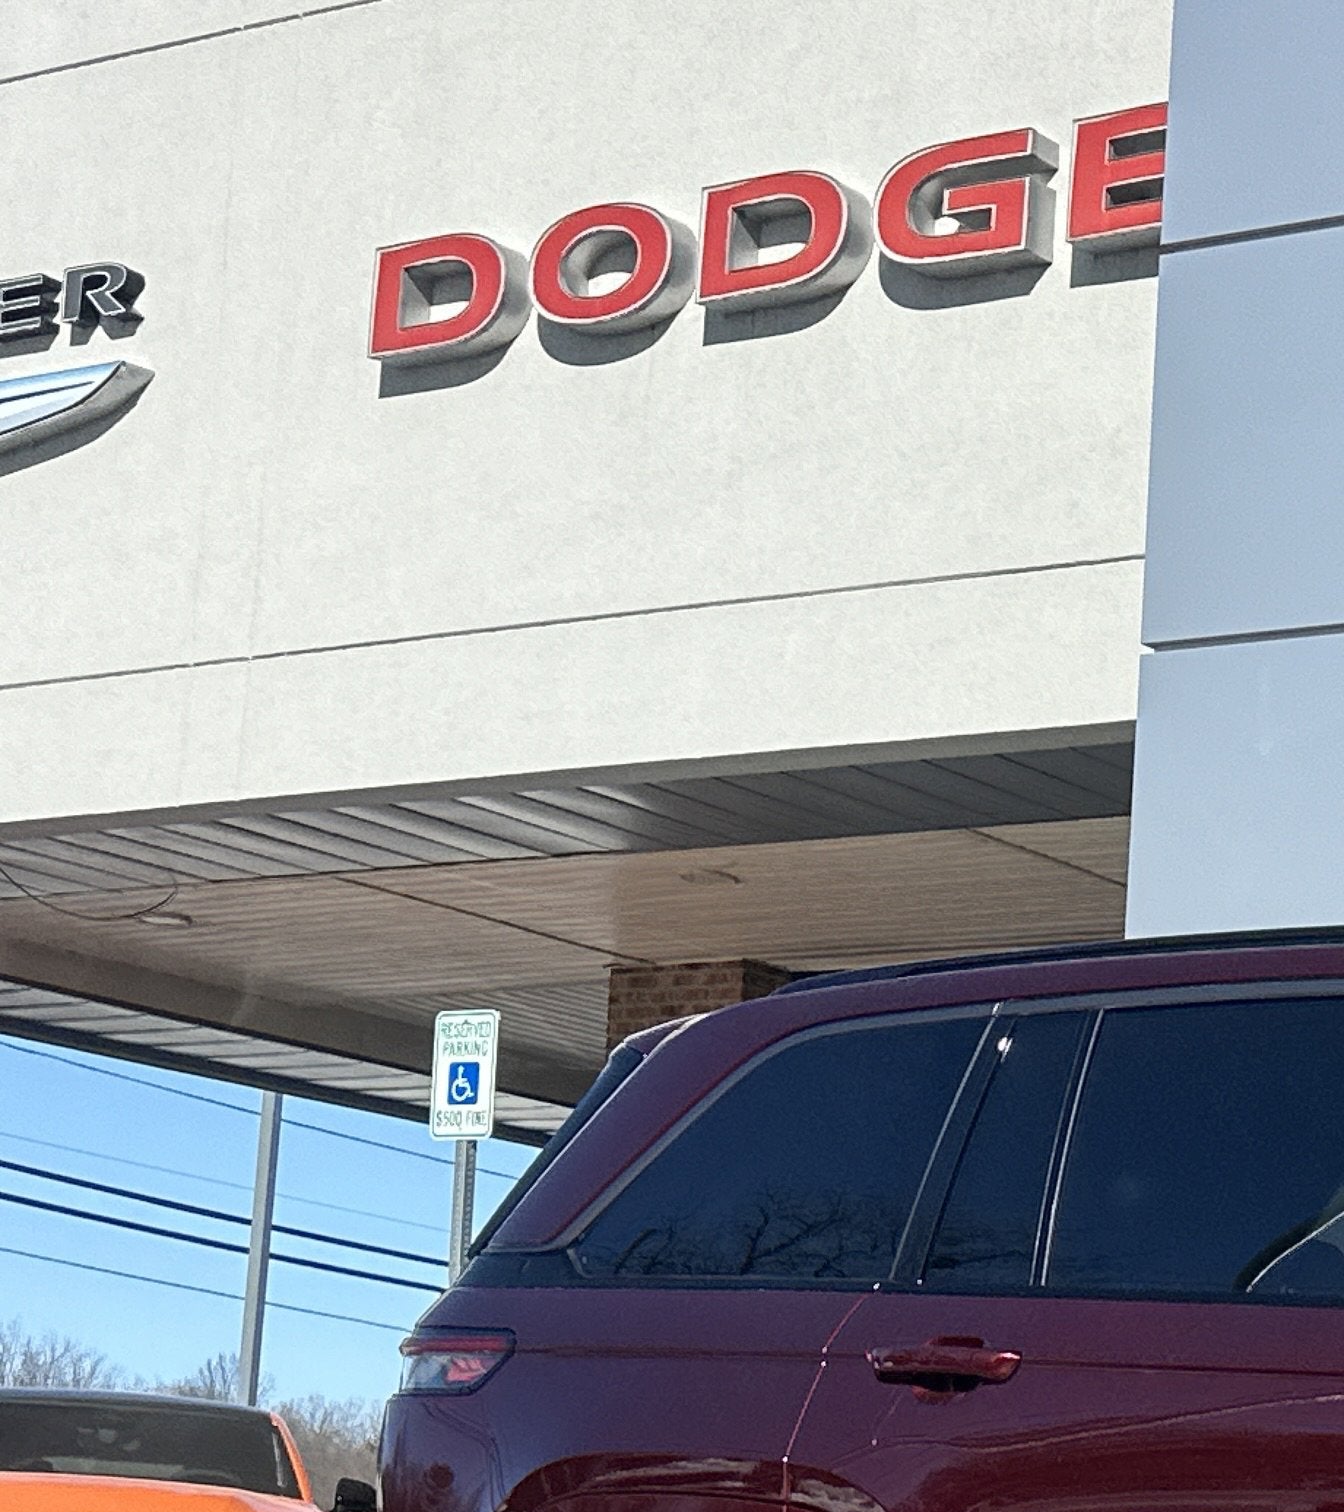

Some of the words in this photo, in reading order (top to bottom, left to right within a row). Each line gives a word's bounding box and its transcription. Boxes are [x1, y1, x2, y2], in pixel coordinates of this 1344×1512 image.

[367, 101, 1169, 361] DODGE
[441, 1020, 491, 1037] RESERVED
[443, 1040, 488, 1056] PARKING
[436, 1110, 462, 1129] $500
